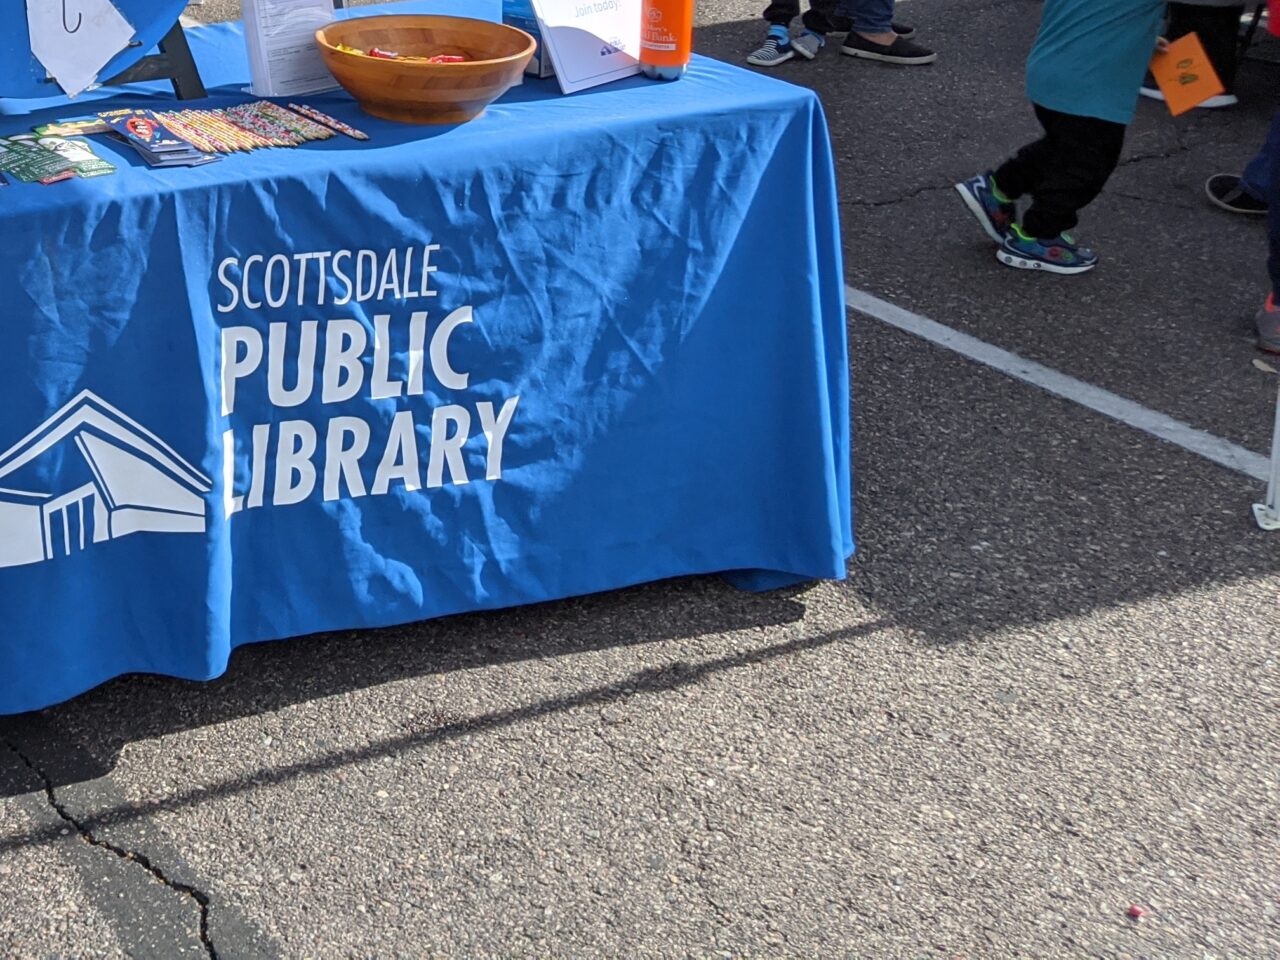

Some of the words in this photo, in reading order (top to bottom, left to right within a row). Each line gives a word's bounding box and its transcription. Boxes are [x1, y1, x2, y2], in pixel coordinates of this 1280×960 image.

[575, 4, 593, 18] Join
[217, 244, 440, 313] SCOTTSDALE
[221, 306, 473, 417] PUBLIC
[222, 396, 520, 521] LIBRARY
